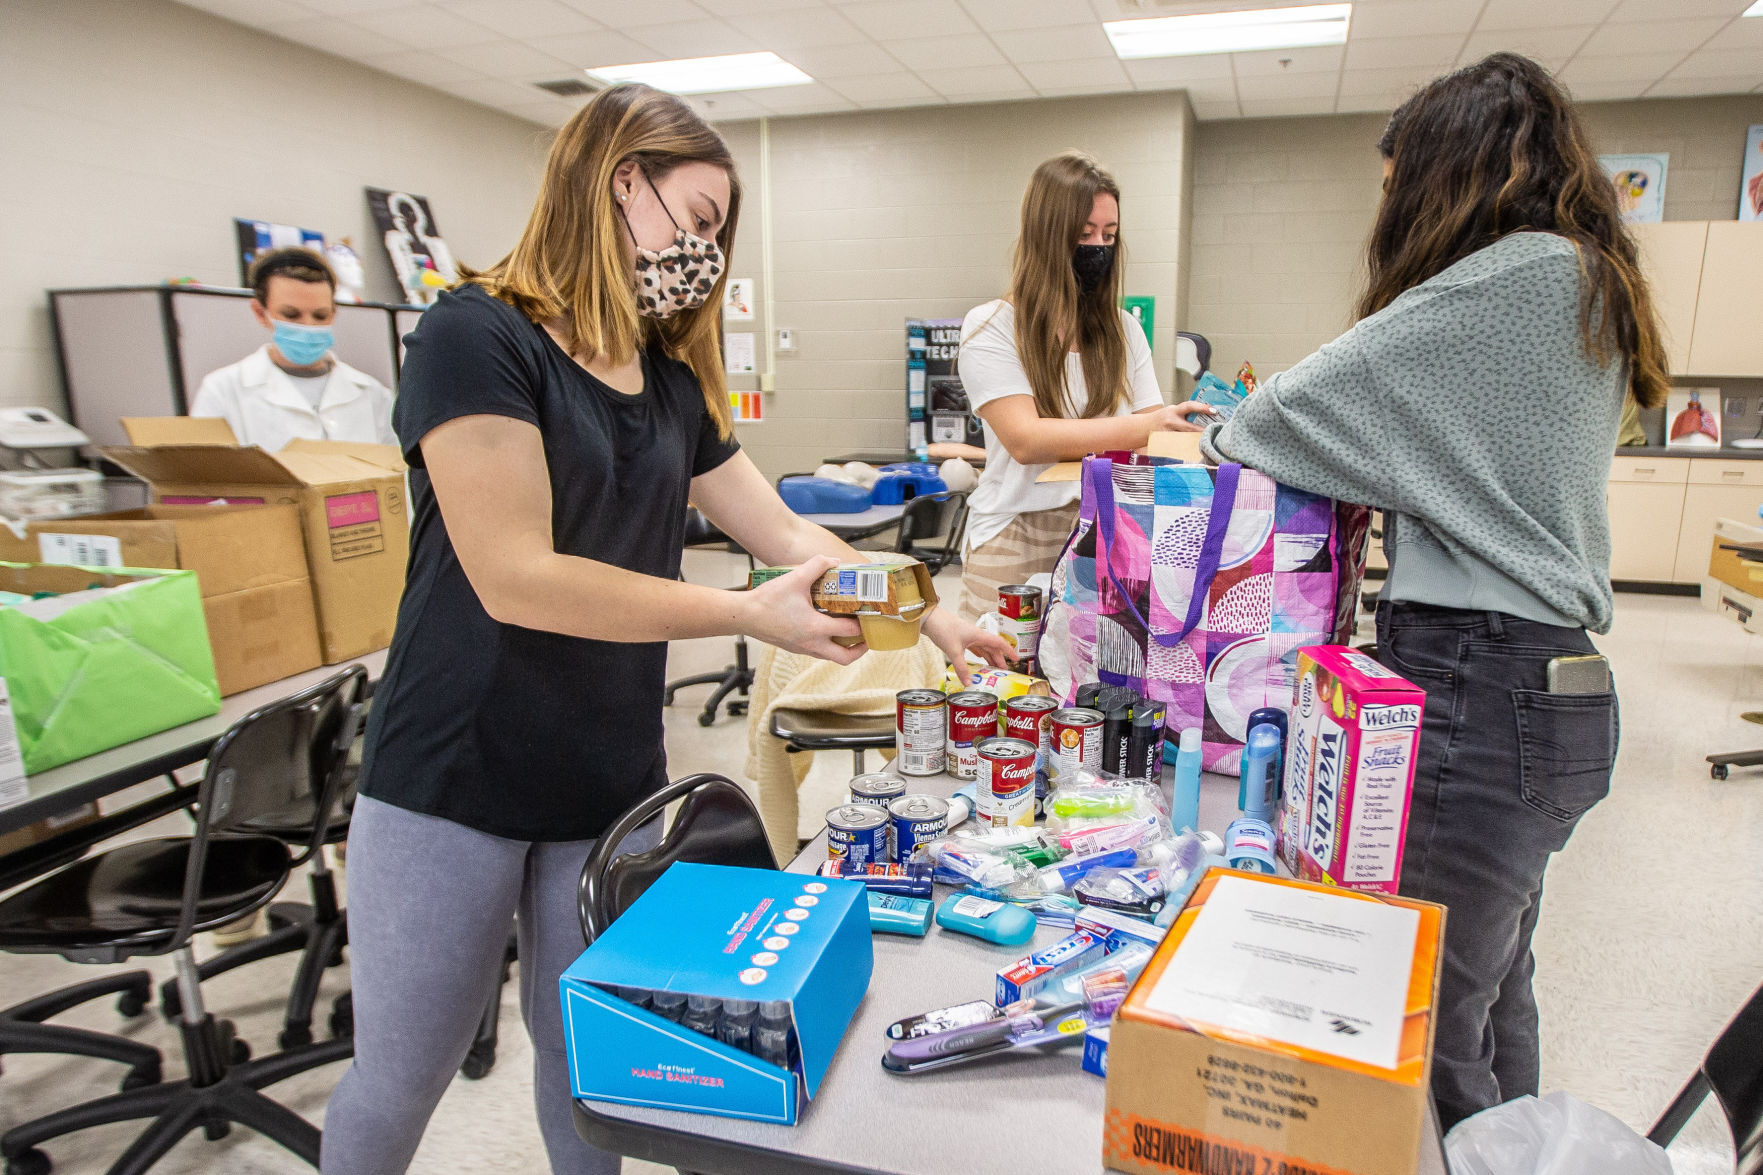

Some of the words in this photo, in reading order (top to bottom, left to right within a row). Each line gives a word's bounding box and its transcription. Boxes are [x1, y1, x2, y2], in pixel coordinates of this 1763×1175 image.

[1364, 707, 1418, 726] Welch's
[1120, 736, 1128, 757] STICK
[1147, 744, 1155, 765] STICK
[1373, 745, 1403, 758] Fruit
[1361, 756, 1407, 769] Snacks
[1313, 732, 1338, 860] Welch's
[914, 832, 936, 842] Vienna
[631, 1067, 663, 1081] HAND
[665, 1072, 725, 1088] SANITIZER
